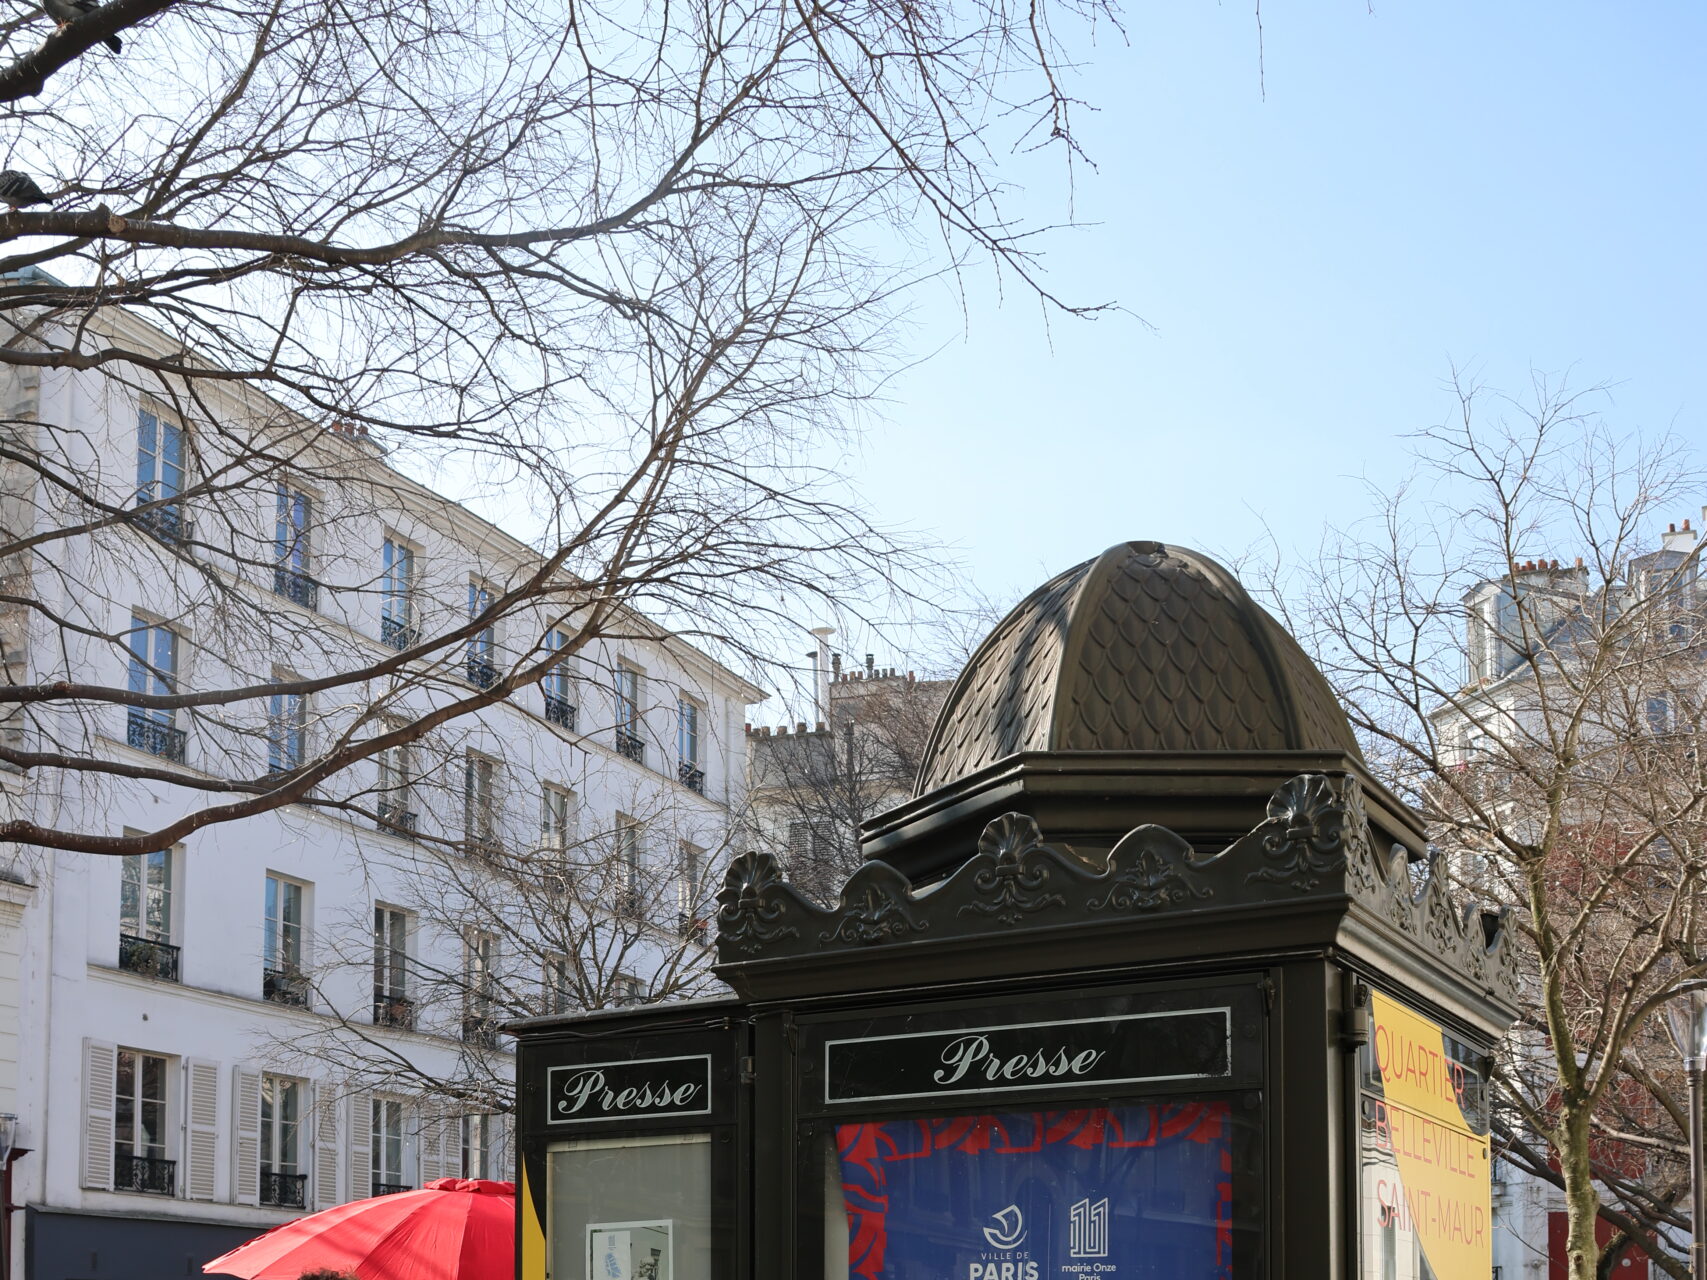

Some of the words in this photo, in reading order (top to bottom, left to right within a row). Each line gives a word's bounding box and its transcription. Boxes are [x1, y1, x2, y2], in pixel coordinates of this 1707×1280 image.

[934, 1034, 1105, 1085] Presse
[1375, 1025, 1465, 1109] QUARTIER
[558, 1069, 702, 1114] Presse
[1375, 1101, 1476, 1179] BELLEVILLE
[1377, 1179, 1484, 1249] SAINT-MAUR
[981, 1252, 1011, 1260] VILLE
[1017, 1251, 1029, 1259] DE
[1062, 1263, 1091, 1272] mairie
[1094, 1263, 1116, 1272] Onze
